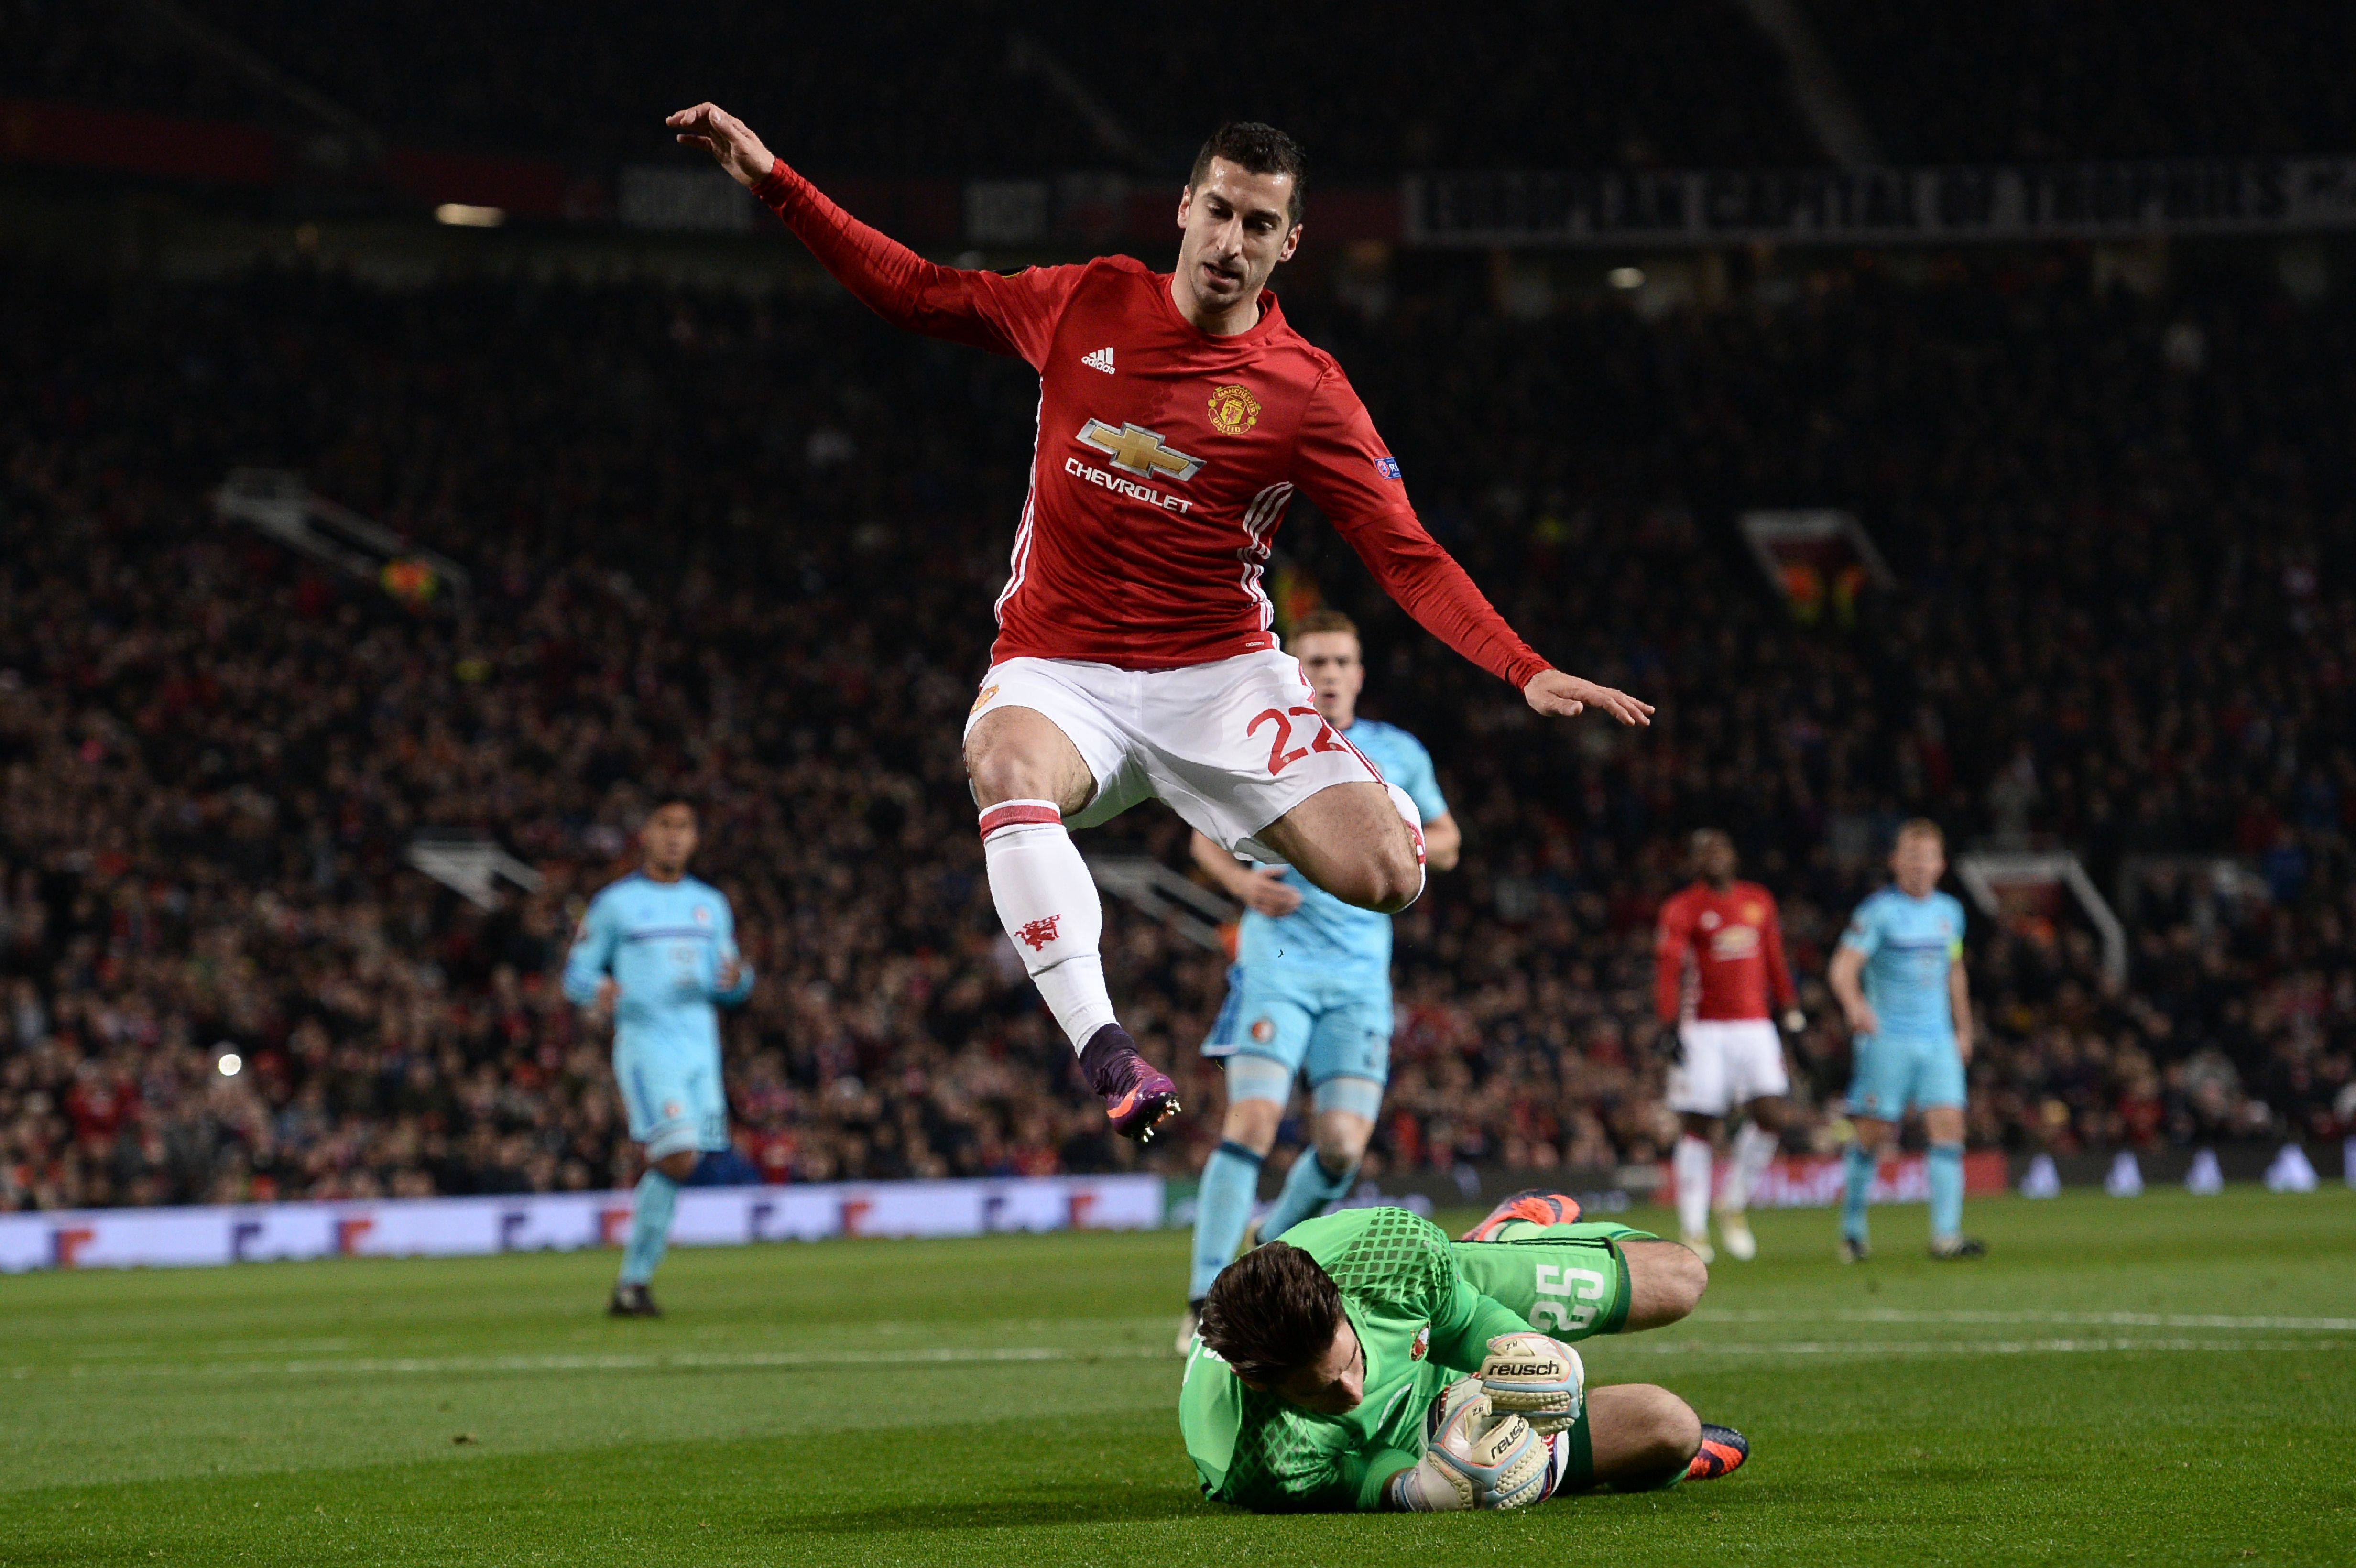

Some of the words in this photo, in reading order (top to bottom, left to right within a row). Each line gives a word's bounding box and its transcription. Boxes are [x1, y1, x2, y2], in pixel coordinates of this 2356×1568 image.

[1081, 356, 1115, 374] adidas
[1065, 457, 1193, 513] CHEVROLET
[1246, 706, 1350, 777] 22
[1528, 1263, 1604, 1331] 25
[1488, 1360, 1560, 1376] reusch
